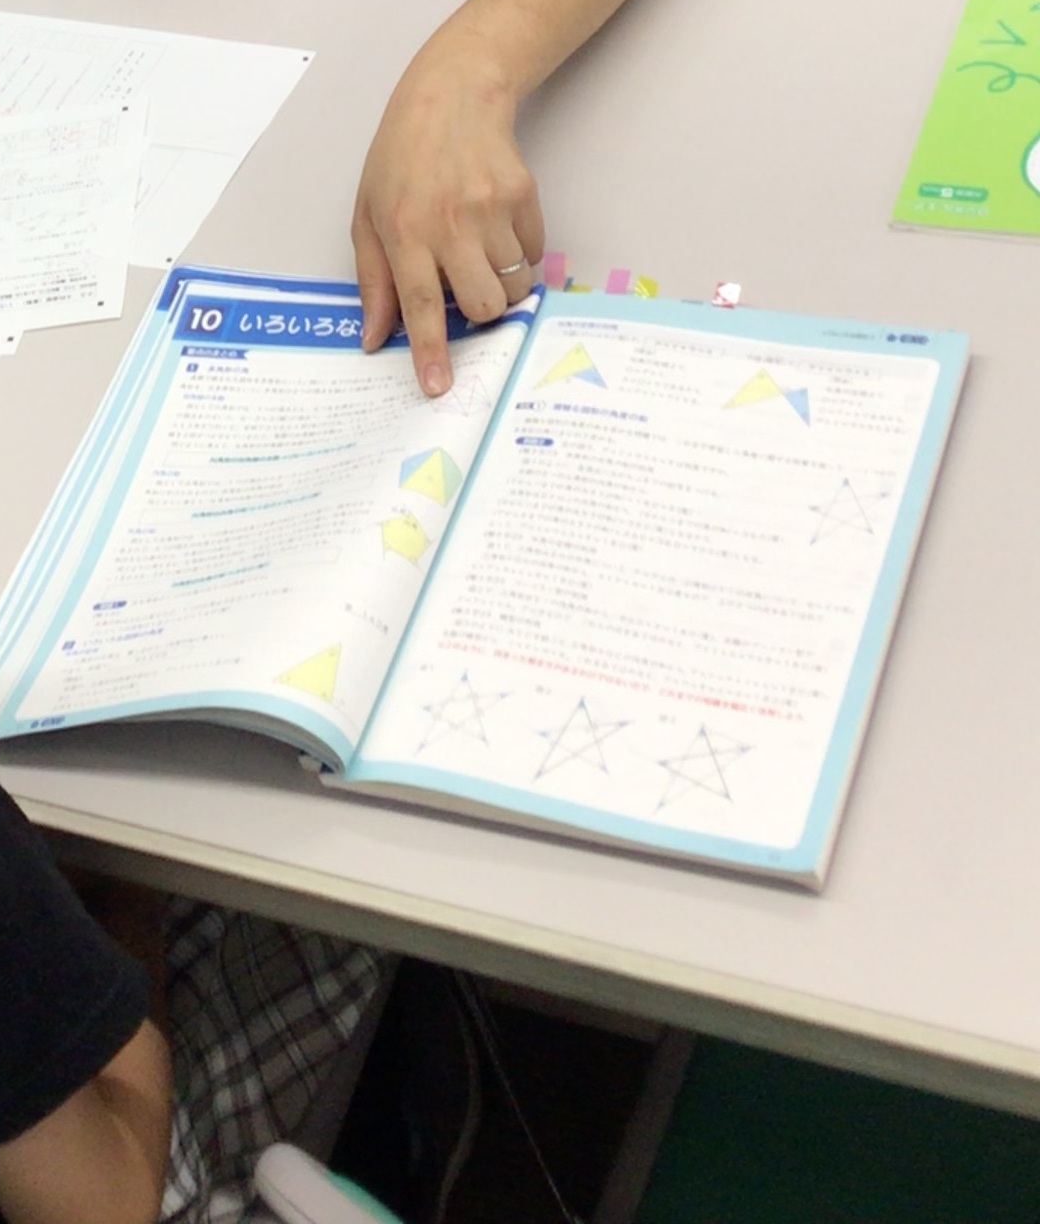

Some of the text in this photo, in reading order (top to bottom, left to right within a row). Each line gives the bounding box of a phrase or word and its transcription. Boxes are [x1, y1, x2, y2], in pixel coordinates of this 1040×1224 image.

[189, 307, 364, 338] 10 いろいろな
